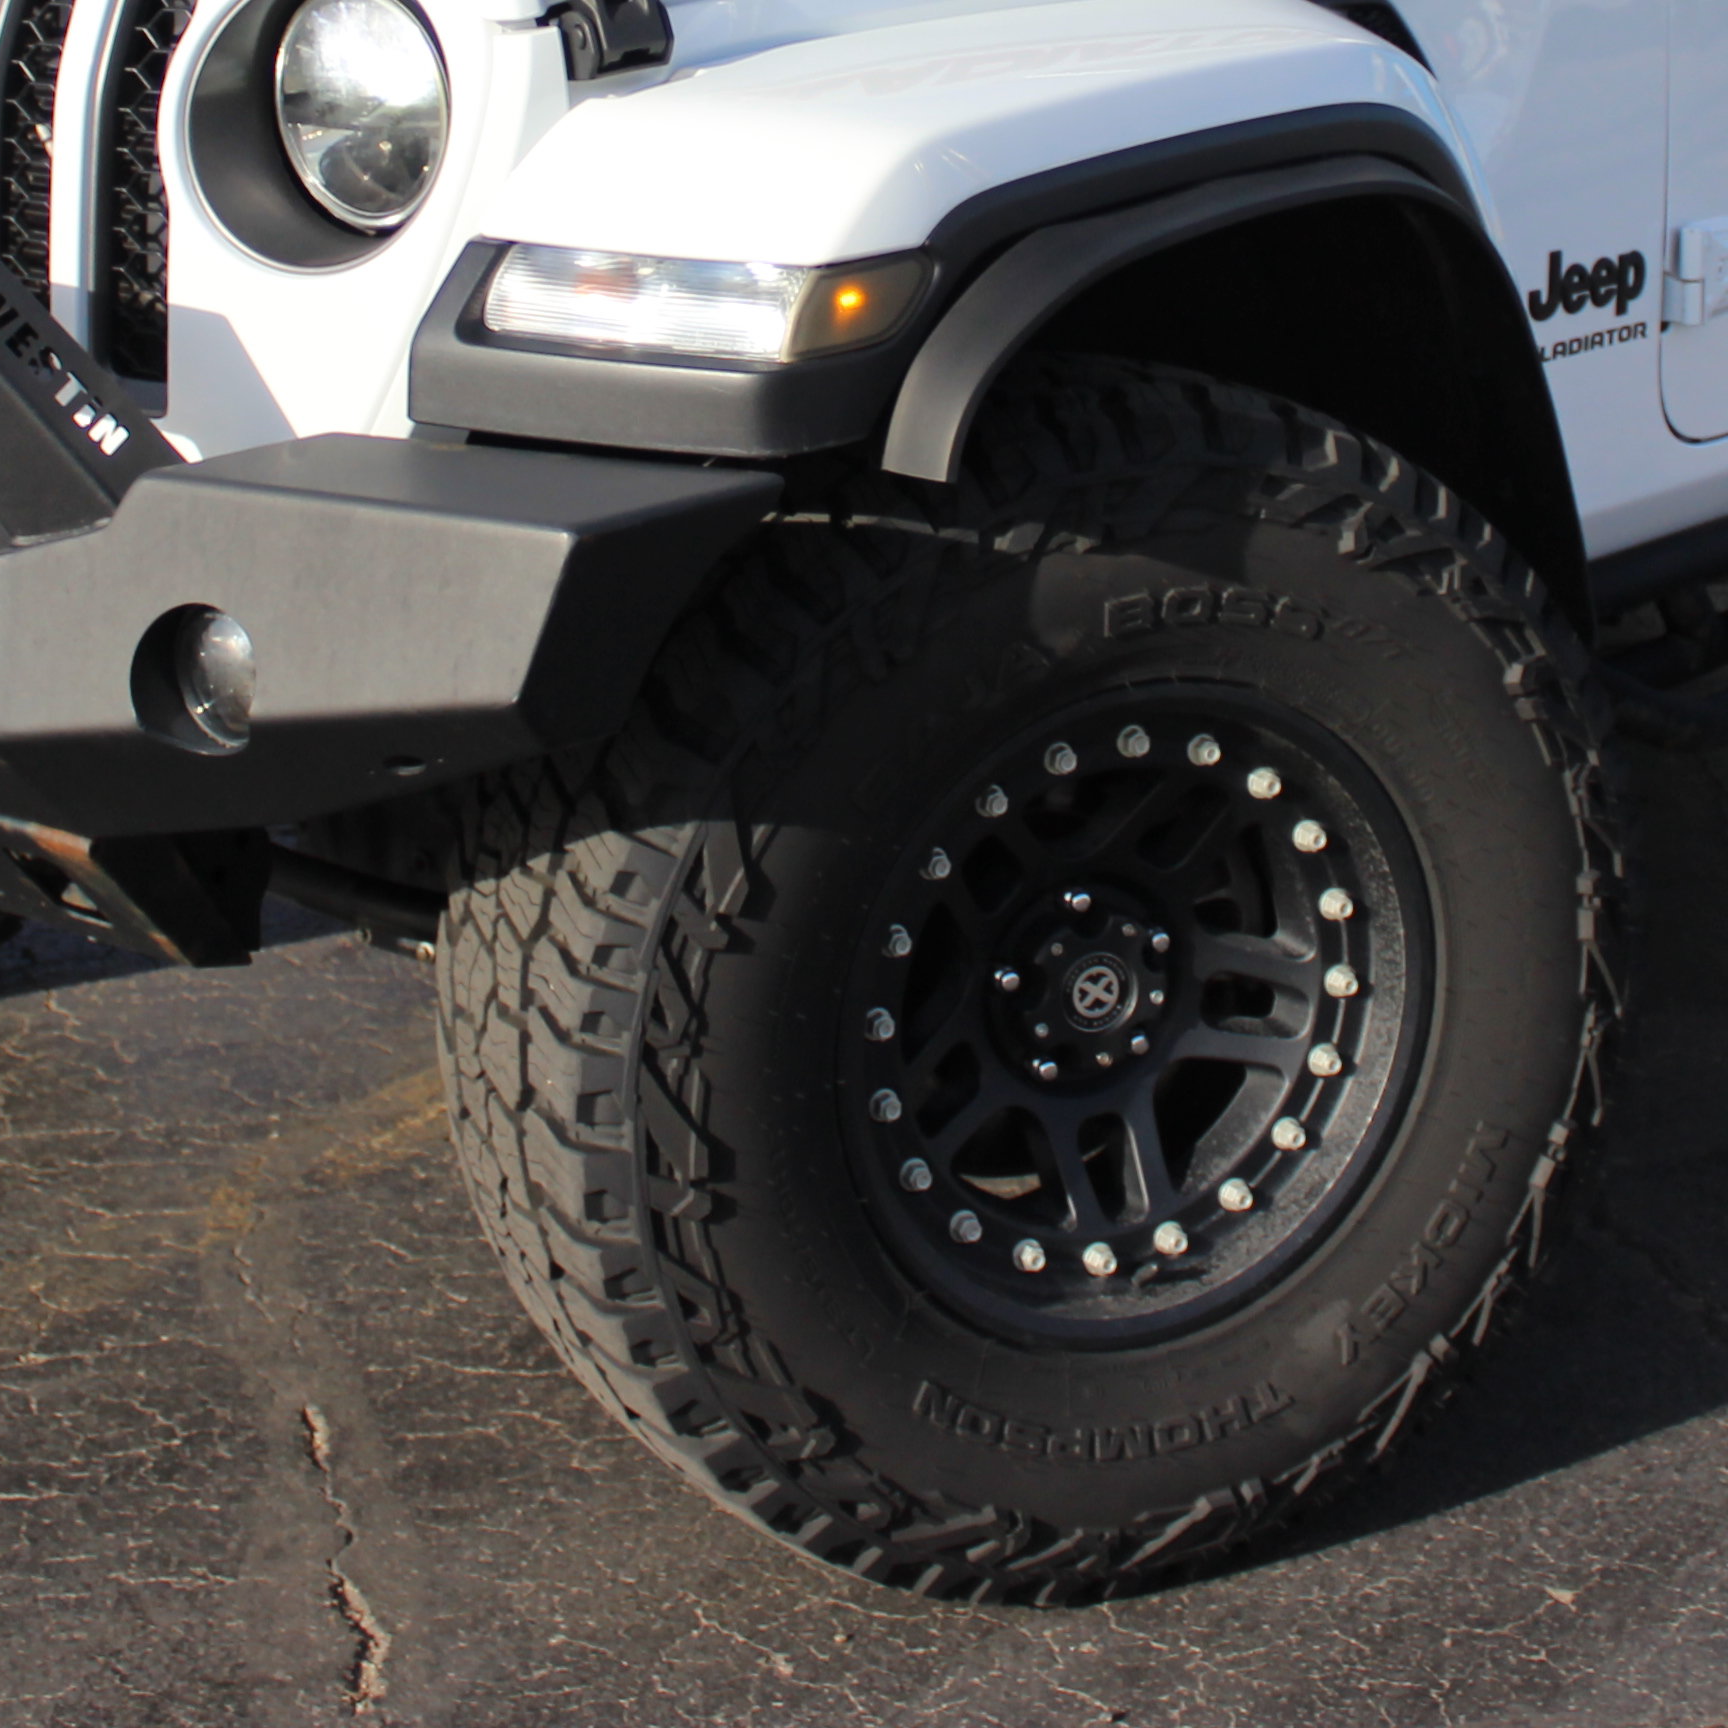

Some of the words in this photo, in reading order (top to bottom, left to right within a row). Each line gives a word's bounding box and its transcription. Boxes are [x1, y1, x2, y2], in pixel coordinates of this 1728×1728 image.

[1528, 250, 1646, 322] Jeep
[1538, 322, 1647, 363] LADIATOR
[1325, 1121, 1511, 1367] MICKEY
[912, 1379, 1296, 1462] THOMPSON
